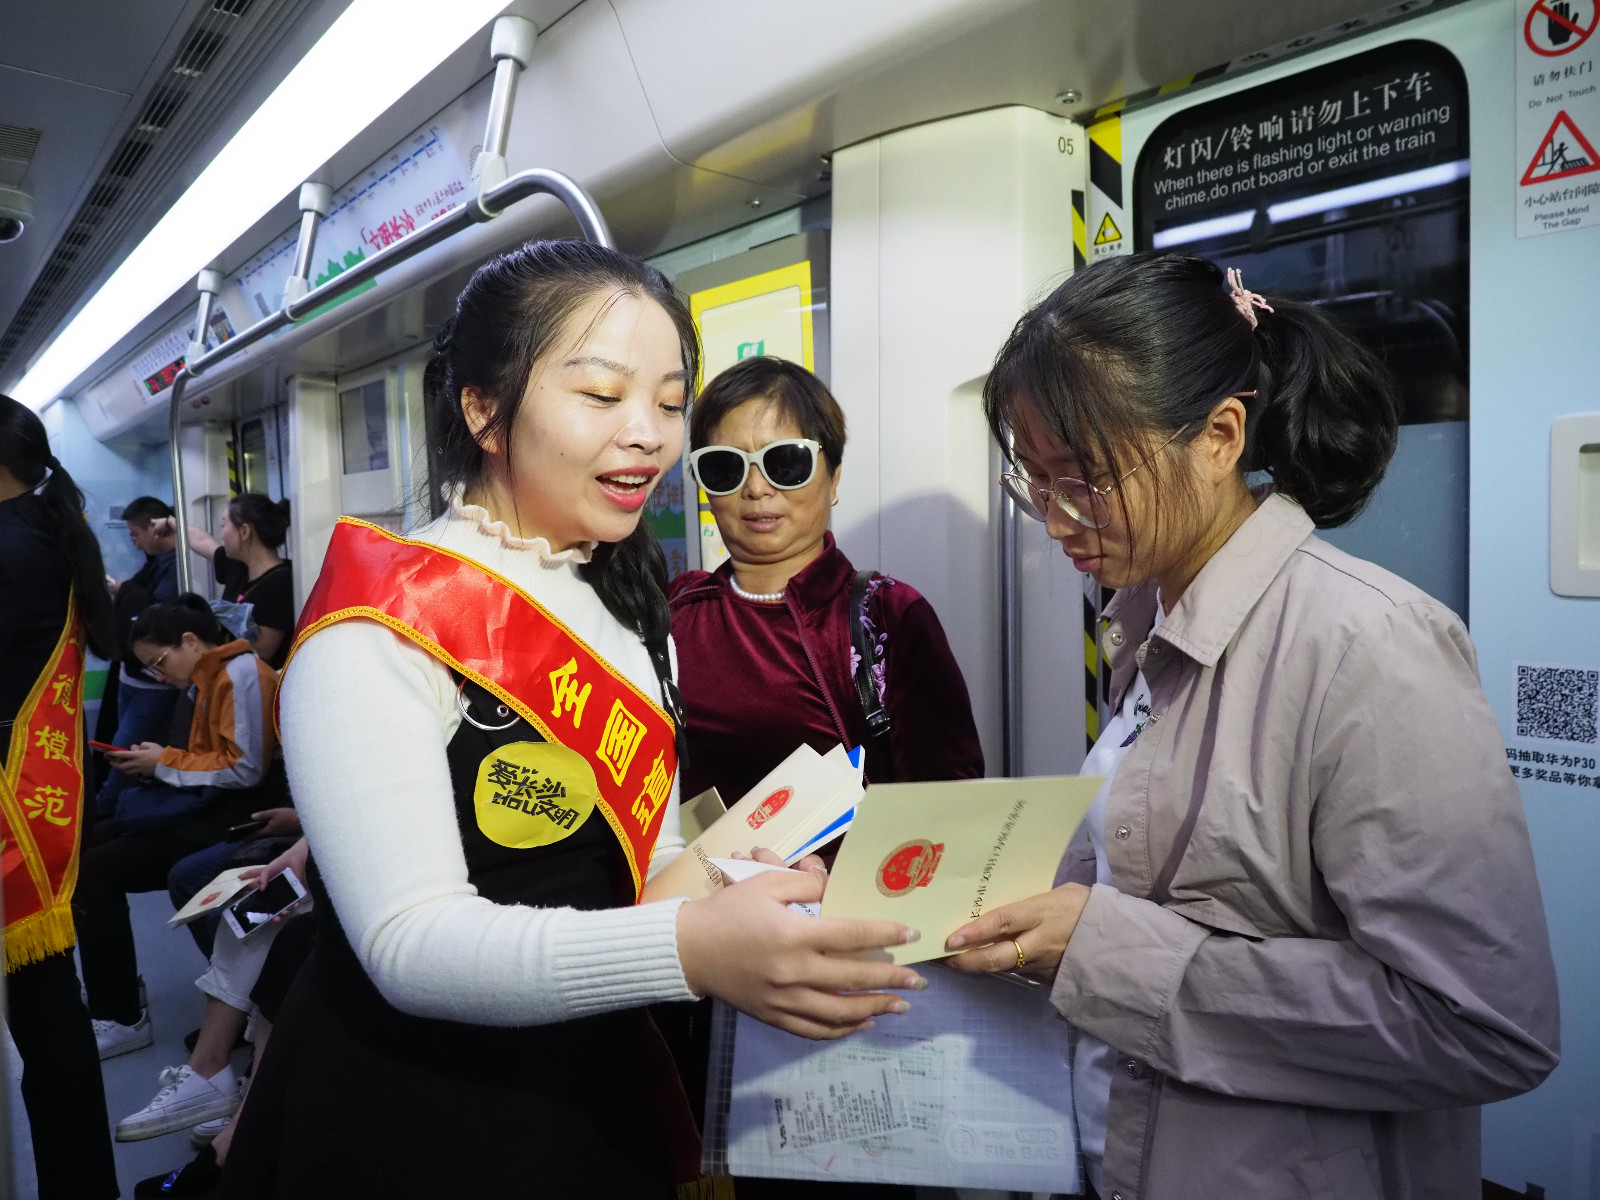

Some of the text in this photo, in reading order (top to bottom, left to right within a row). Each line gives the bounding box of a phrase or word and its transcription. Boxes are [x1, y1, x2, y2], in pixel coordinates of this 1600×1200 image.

[1528, 85, 1596, 109] Do Not Touch
[1163, 72, 1432, 171] 灯闪/铃响请勿上下车
[1058, 136, 1074, 155] 05
[1154, 105, 1450, 196] When there is flashing light or warning
[1232, 175, 1256, 194] not
[1259, 162, 1304, 187] board
[1308, 159, 1325, 174] or
[1328, 148, 1358, 169] exit
[1363, 140, 1390, 160] the
[1395, 130, 1436, 152] train
[1534, 204, 1590, 222] Please Mind
[1561, 217, 1581, 227] Gap
